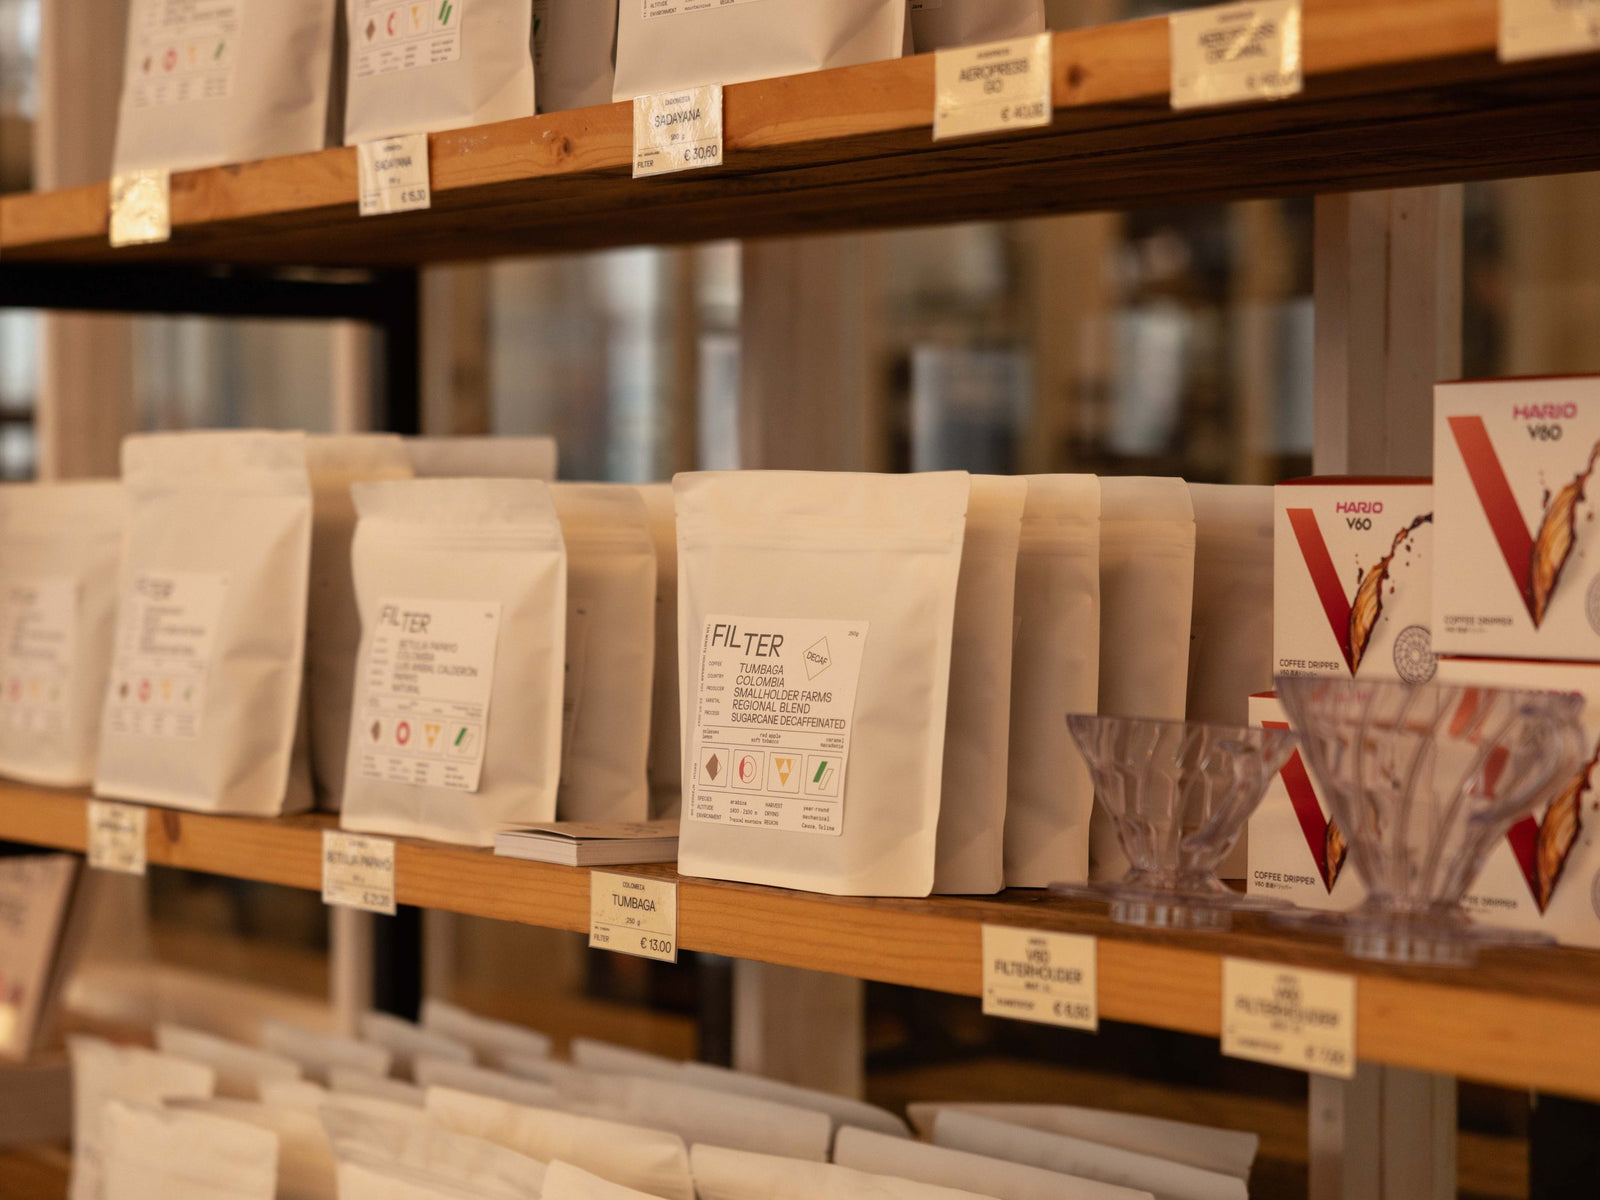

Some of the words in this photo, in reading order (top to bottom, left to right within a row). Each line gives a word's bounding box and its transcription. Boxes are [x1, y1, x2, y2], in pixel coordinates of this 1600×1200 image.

[654, 108, 702, 128] SADAYANA
[637, 160, 655, 169] FILTER
[1513, 403, 1578, 420] HARIO
[1526, 424, 1563, 441] V60
[1336, 502, 1384, 514] HARIO
[1346, 518, 1372, 531] V60
[381, 604, 432, 634] FILTER
[711, 624, 784, 658] FILTER
[806, 650, 828, 666] DECAF
[1280, 659, 1306, 669] COFFEE
[1308, 661, 1340, 671] DRIPPER
[740, 662, 784, 676] TUMBAGA
[735, 675, 785, 688] COLOMBIA
[733, 686, 800, 702] SMALLHOLDER
[801, 690, 833, 704] FARMS
[732, 699, 777, 713] REGIONAL
[779, 702, 811, 715] BLEND
[730, 712, 779, 726] SUGARCANE
[779, 715, 847, 730] DECAFFEINATED
[622, 881, 646, 891] COLOMBIA
[1254, 871, 1282, 882] COFFEE
[1283, 874, 1316, 886] DRIPPER
[612, 893, 656, 912] TUMBAGA
[626, 917, 636, 926] 250
[594, 933, 610, 943] FILTER
[640, 936, 648, 950] €
